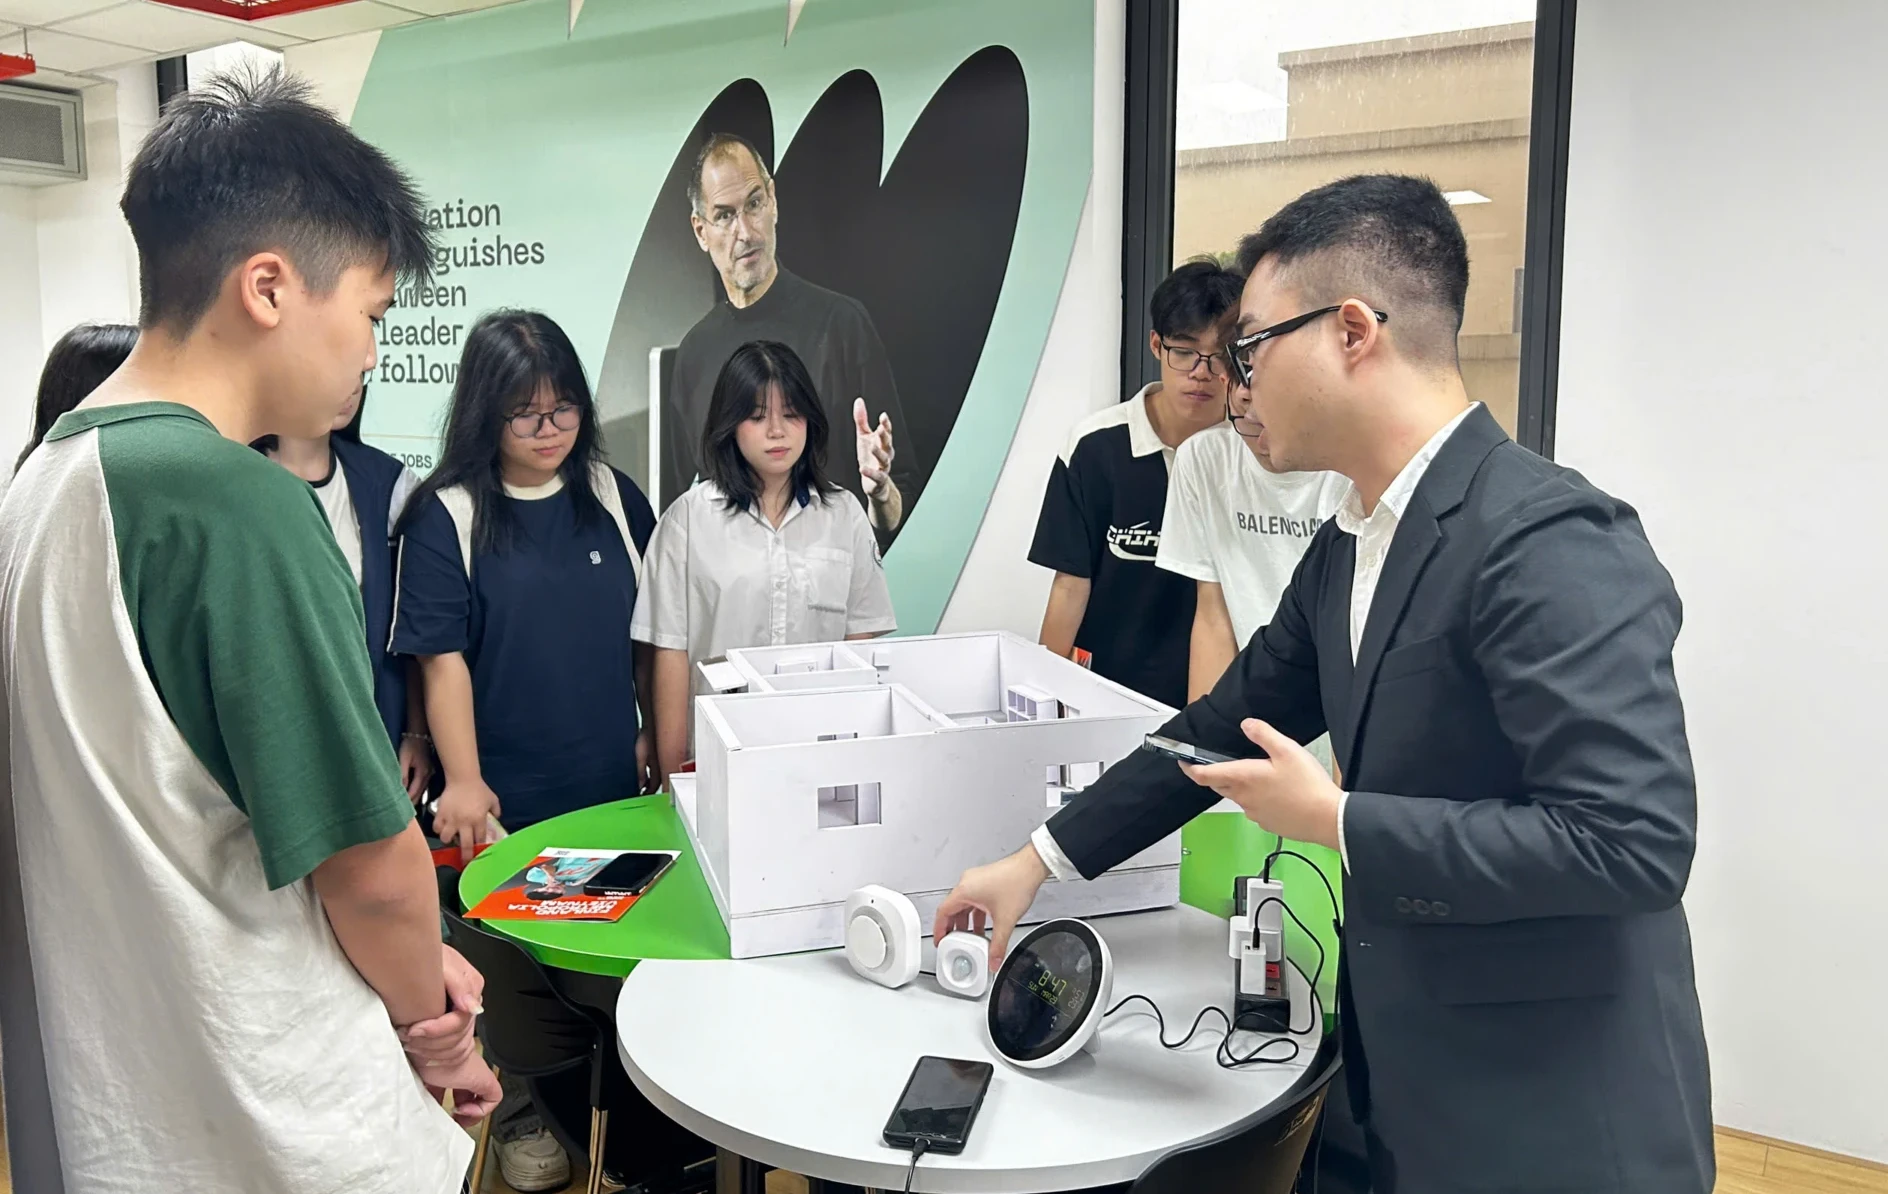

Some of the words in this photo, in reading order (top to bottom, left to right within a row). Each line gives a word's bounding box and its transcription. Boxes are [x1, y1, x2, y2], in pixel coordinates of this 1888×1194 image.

[425, 198, 501, 229] ation
[434, 234, 546, 276] guishes
[393, 285, 467, 308] ween
[379, 316, 464, 346] leader
[401, 453, 433, 469] JOBS
[1237, 512, 1323, 538] BALENCIA
